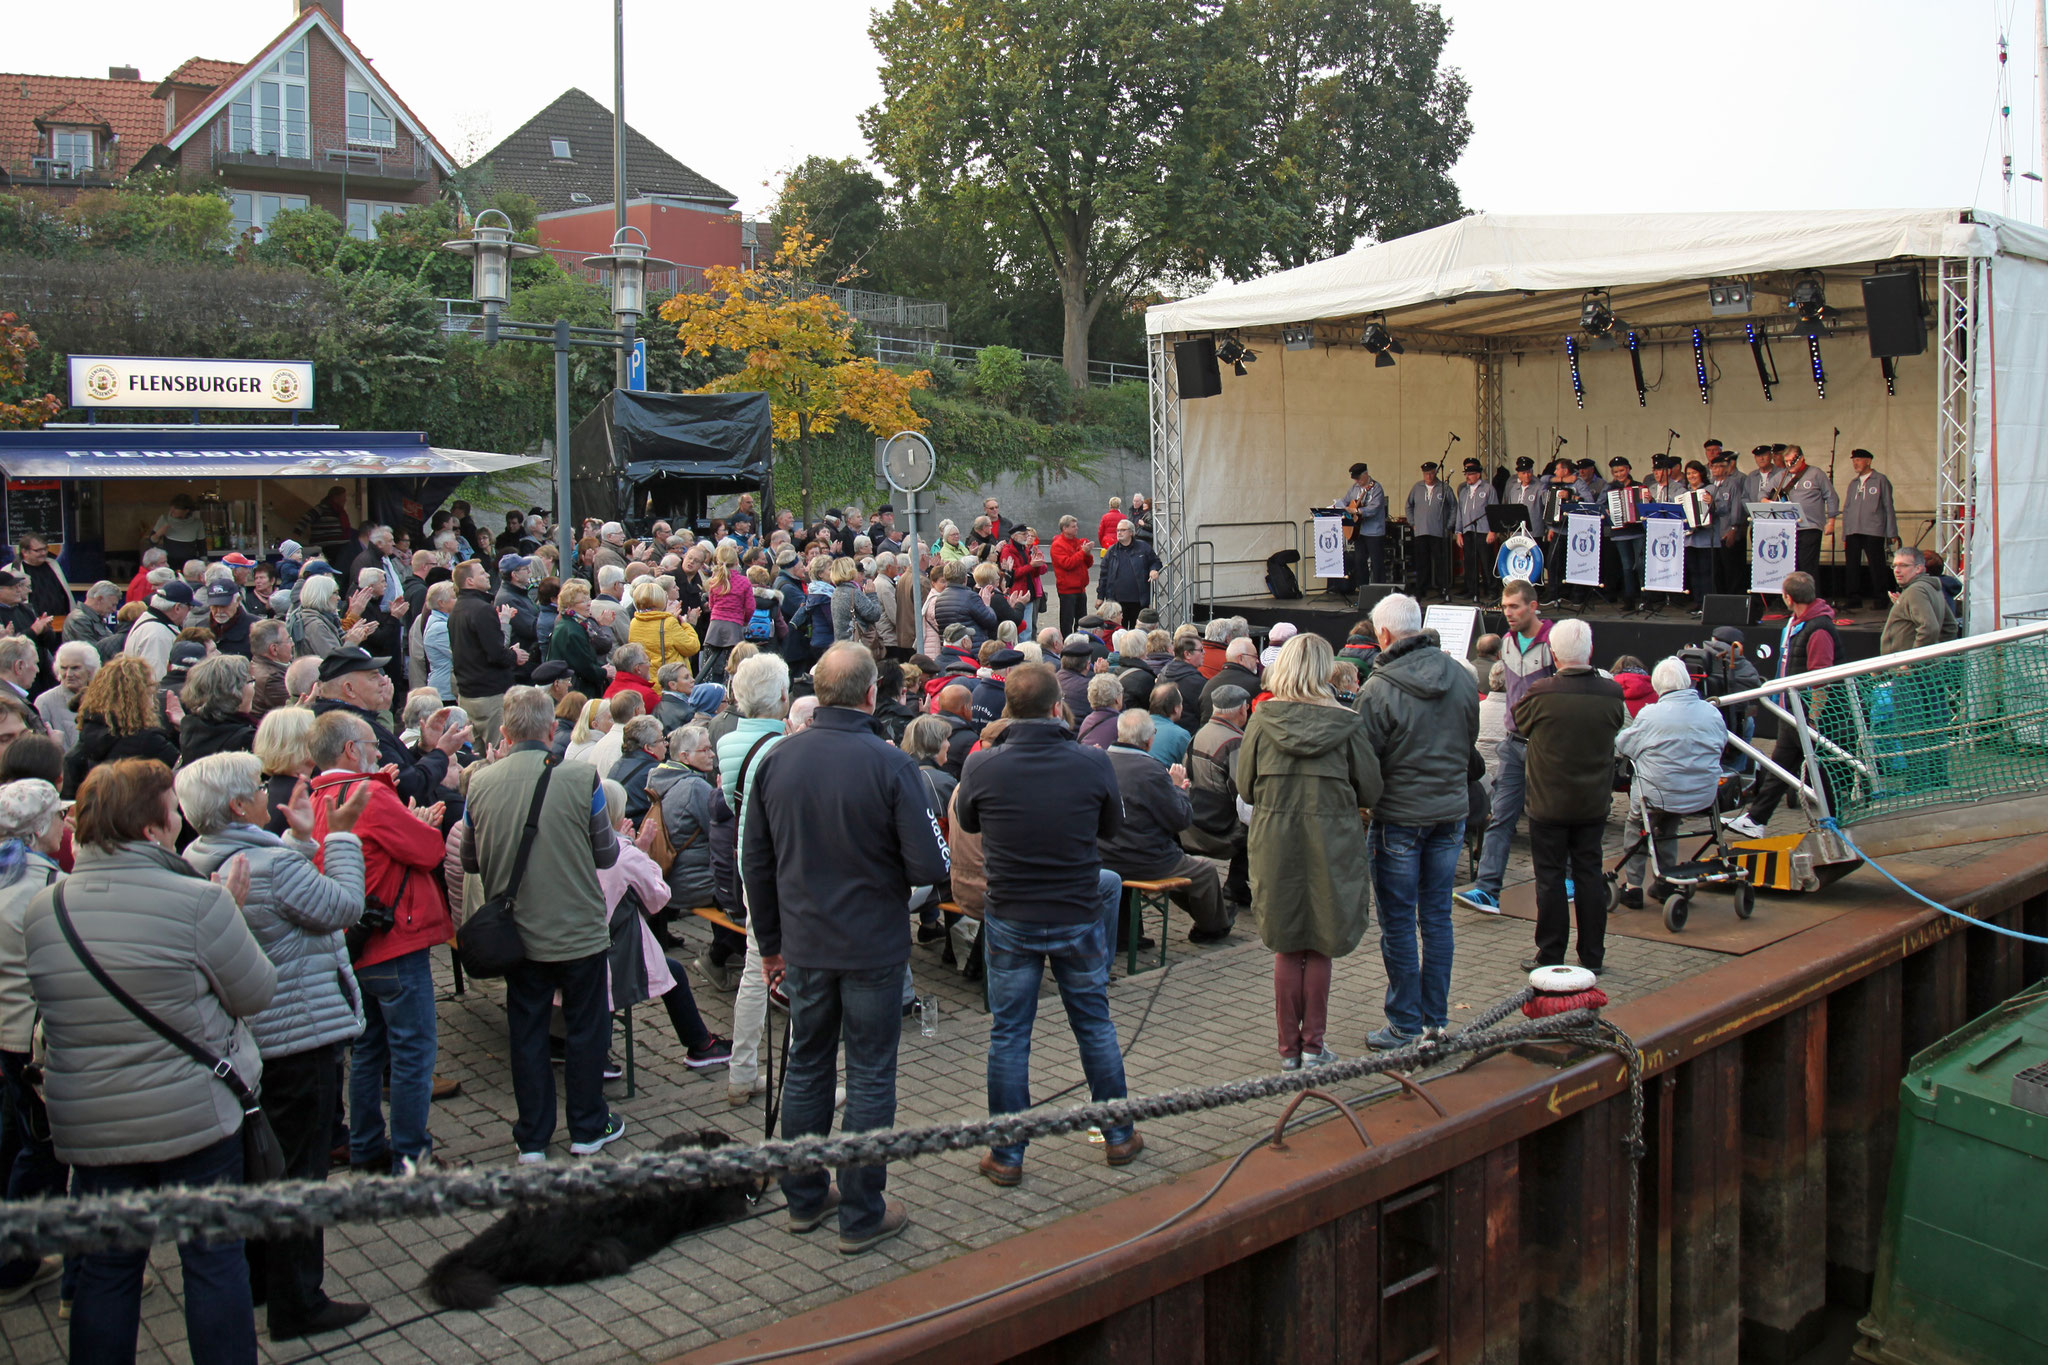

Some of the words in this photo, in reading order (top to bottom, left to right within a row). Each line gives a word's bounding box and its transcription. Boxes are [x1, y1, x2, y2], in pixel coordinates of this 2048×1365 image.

[632, 349, 641, 379] P
[128, 374, 262, 393] FLENSBURGER
[65, 450, 377, 458] FLENSBURGER
